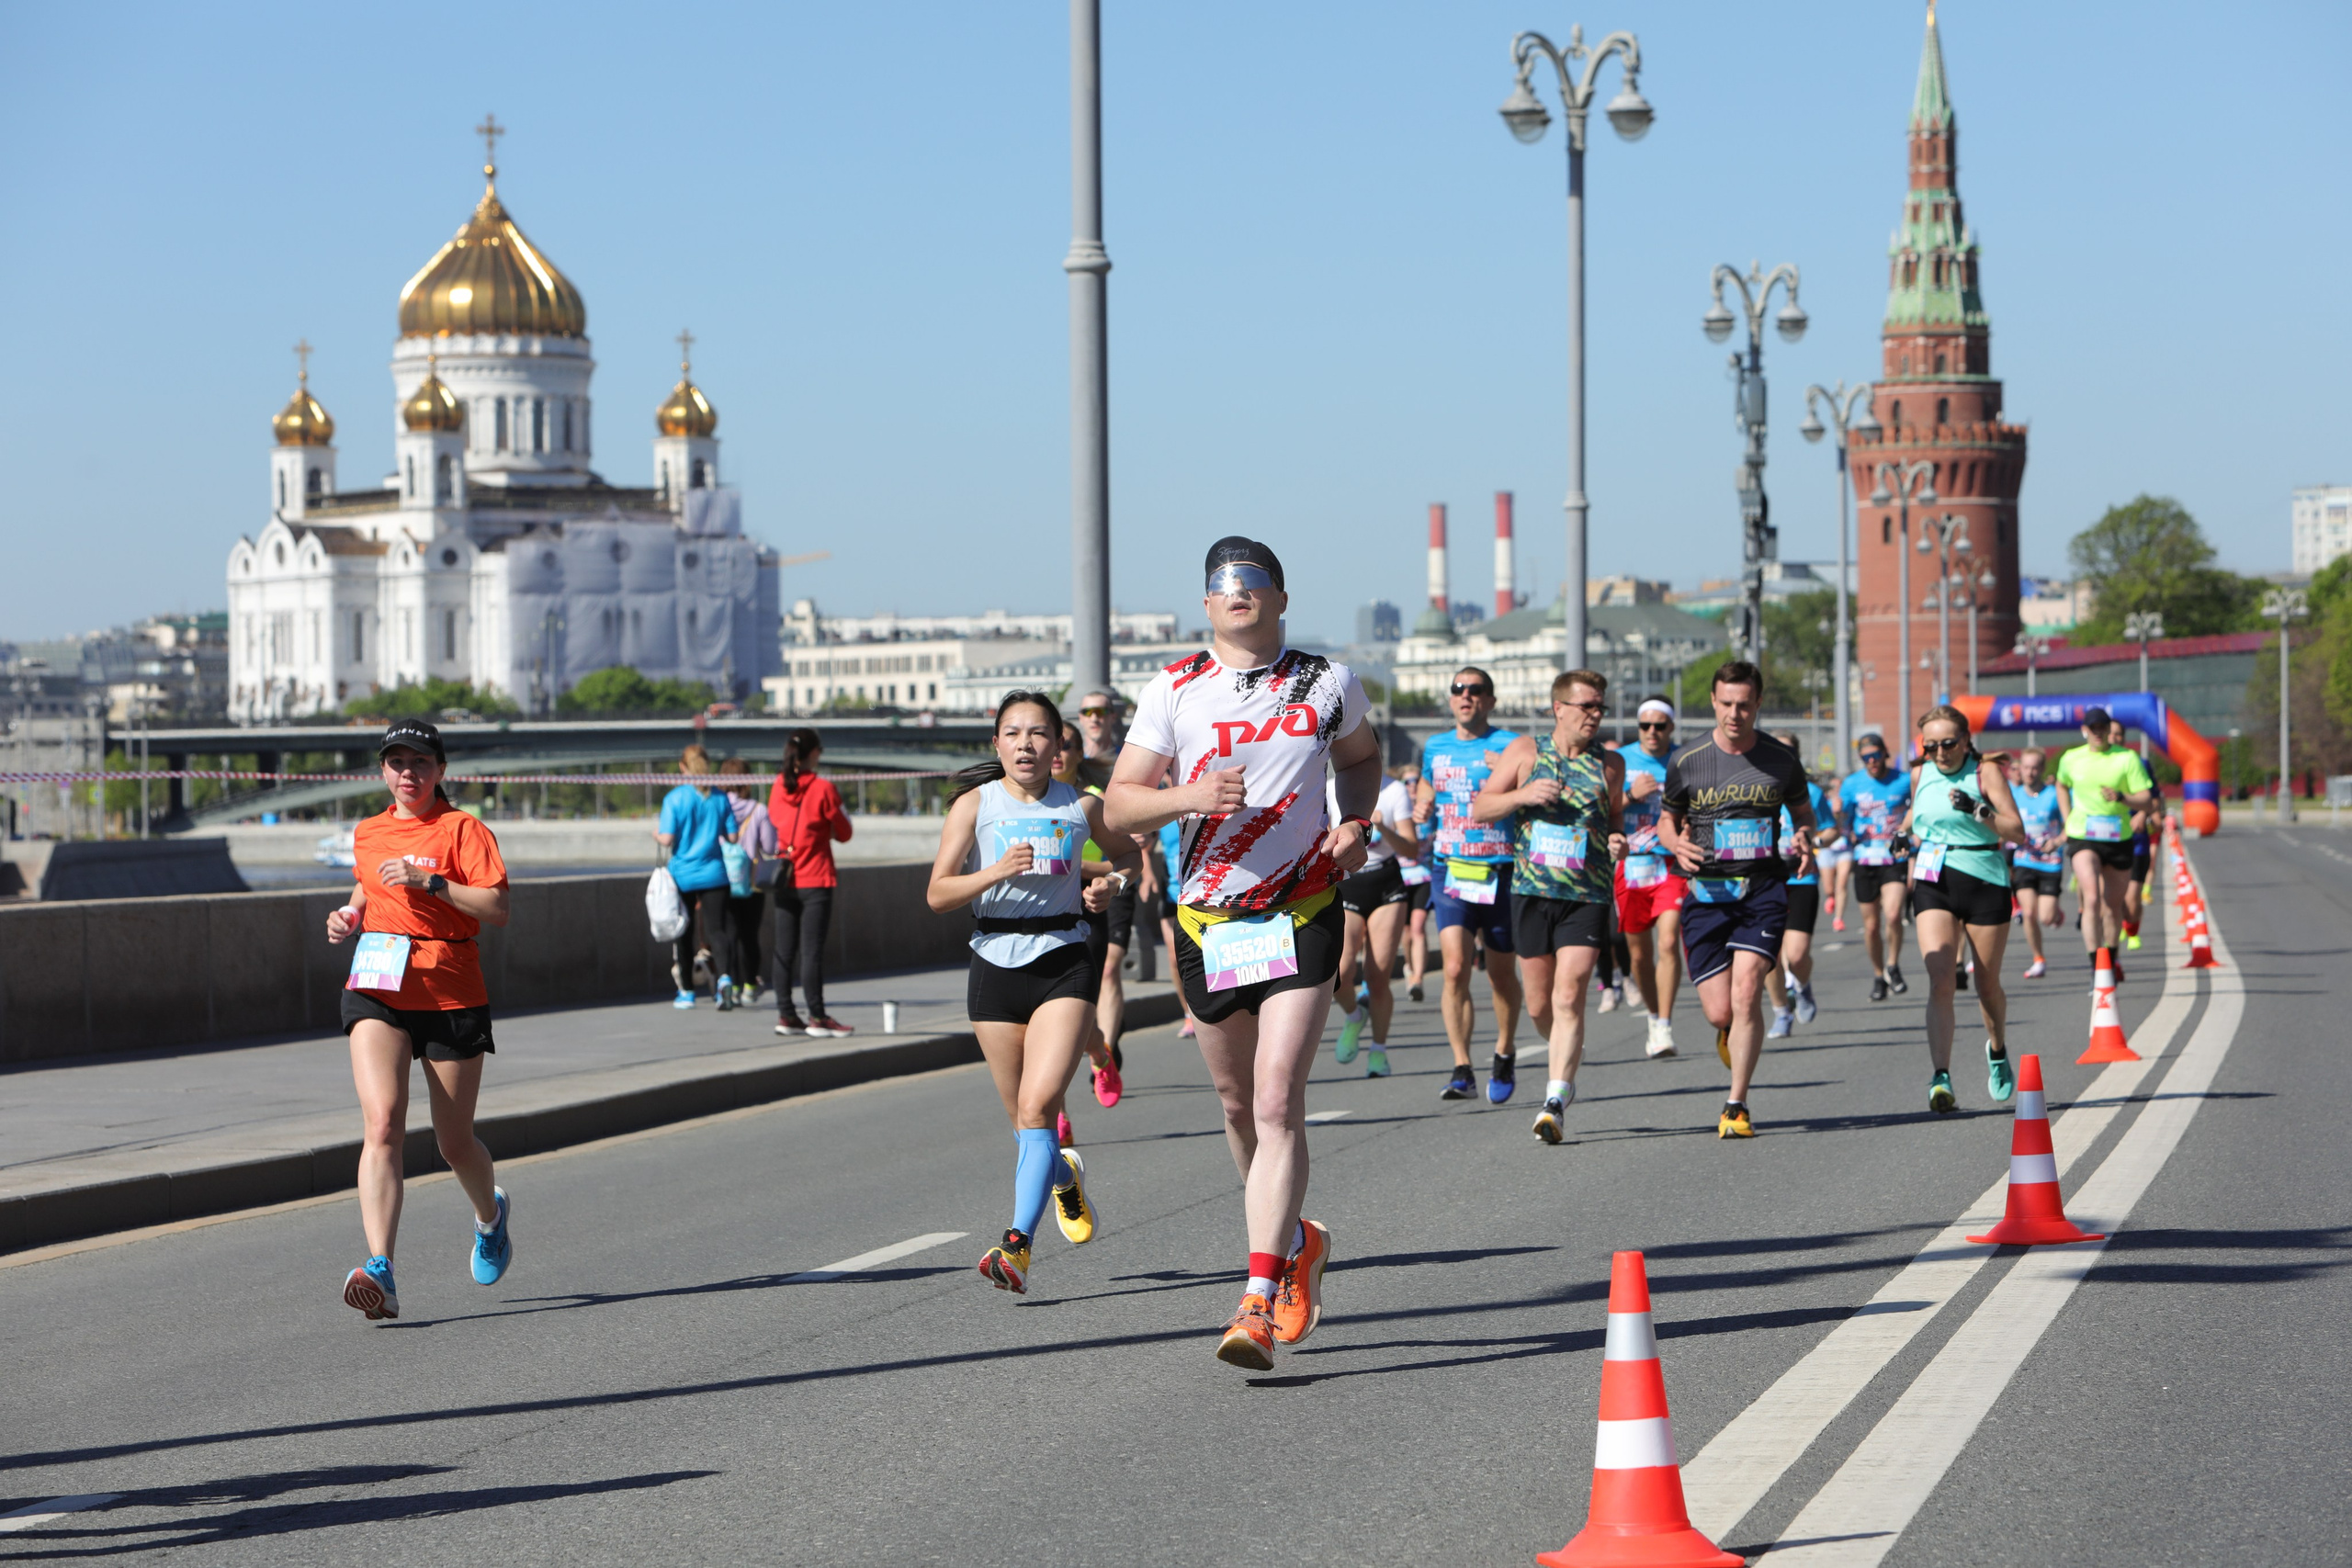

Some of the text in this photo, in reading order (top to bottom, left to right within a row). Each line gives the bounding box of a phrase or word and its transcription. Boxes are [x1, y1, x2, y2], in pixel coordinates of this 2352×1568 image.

[1009, 836, 1060, 857] 998
[1540, 836, 1576, 856] 33273
[1727, 830, 1760, 848] 31144
[1219, 933, 1279, 967] 35520
